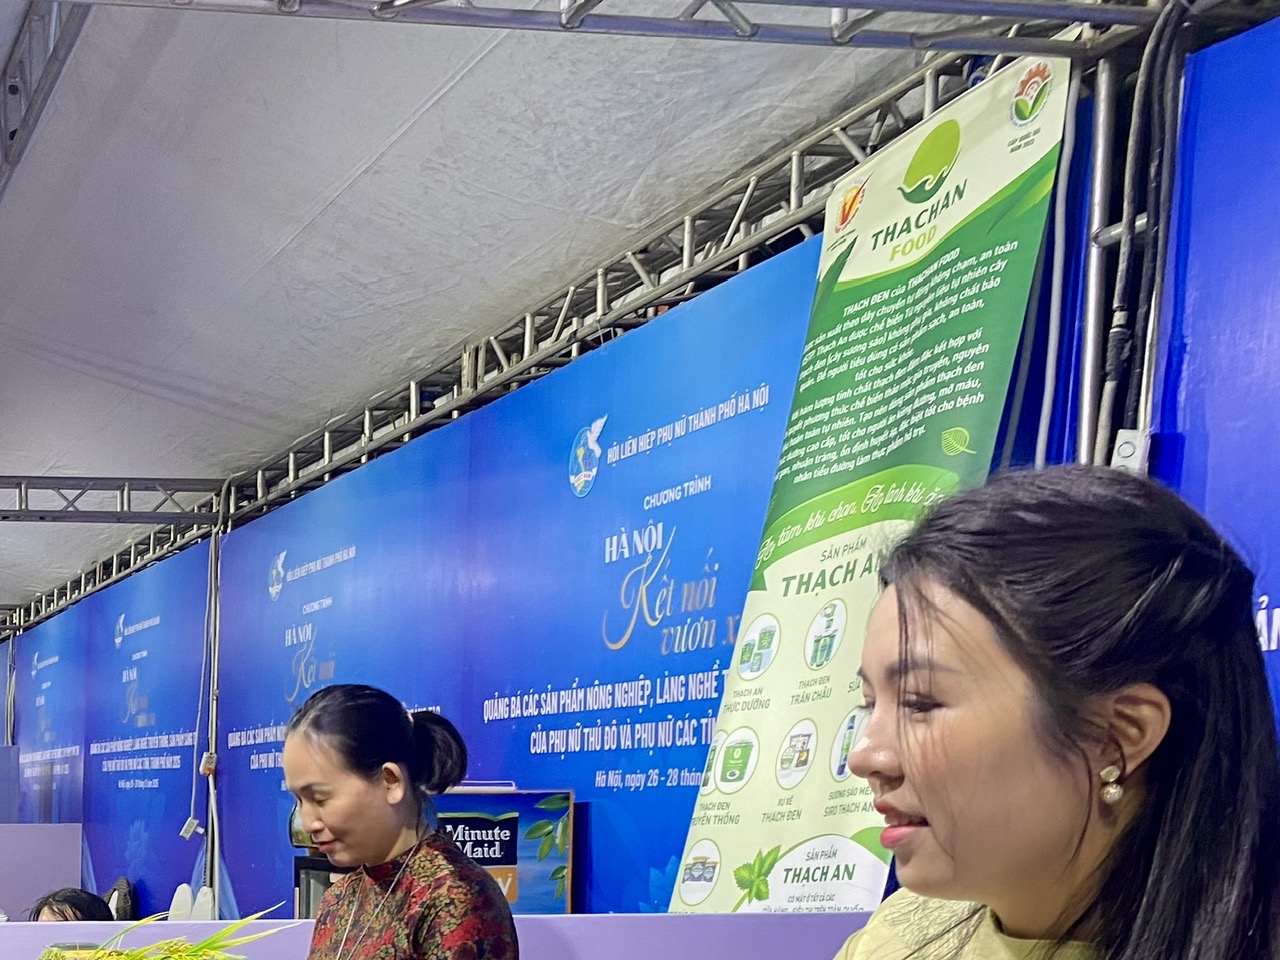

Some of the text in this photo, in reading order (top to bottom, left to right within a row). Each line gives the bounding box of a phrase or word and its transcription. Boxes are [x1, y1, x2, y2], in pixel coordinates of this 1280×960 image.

[870, 179, 968, 251] THACHAN
[889, 224, 938, 261] FOOD
[979, 241, 1018, 262] an toàn
[948, 308, 960, 319] an
[963, 361, 984, 375] đen
[937, 400, 955, 413] cho
[956, 392, 984, 408] bệnh
[620, 436, 637, 460] LIÊN
[638, 428, 656, 455] HIỆP
[657, 423, 673, 447] PHỤ
[688, 407, 716, 433] THÀNH
[718, 390, 738, 422] PHỐ
[738, 389, 750, 415] HÀ
[752, 382, 770, 413] NỘI
[643, 474, 712, 511] CHƯƠNG TRÌNH
[604, 518, 663, 563] HÀ NỘI
[820, 533, 868, 562] SẢN PHẨM
[602, 526, 720, 651] Kết nối
[782, 559, 857, 597] THẠCH
[483, 691, 509, 724] QUẢNG
[510, 690, 521, 719] BÁ
[522, 688, 539, 717] CÁC
[540, 684, 558, 715] SẢN
[559, 677, 584, 714] PHẨM
[586, 679, 612, 711] NÔNG
[614, 674, 654, 714] NGHIỆP,
[656, 671, 685, 704] LÀNG
[688, 659, 720, 700] NGHỀ
[530, 713, 697, 760] CỦA PHỤ NỮ THỦ ĐÔ VÀ PHỤ NỮ CÁC
[594, 768, 679, 792] Hà Nội, ngày 26 28
[445, 824, 511, 841] Minute
[455, 841, 502, 858] Maid
[783, 864, 856, 888] THẠCH AN
